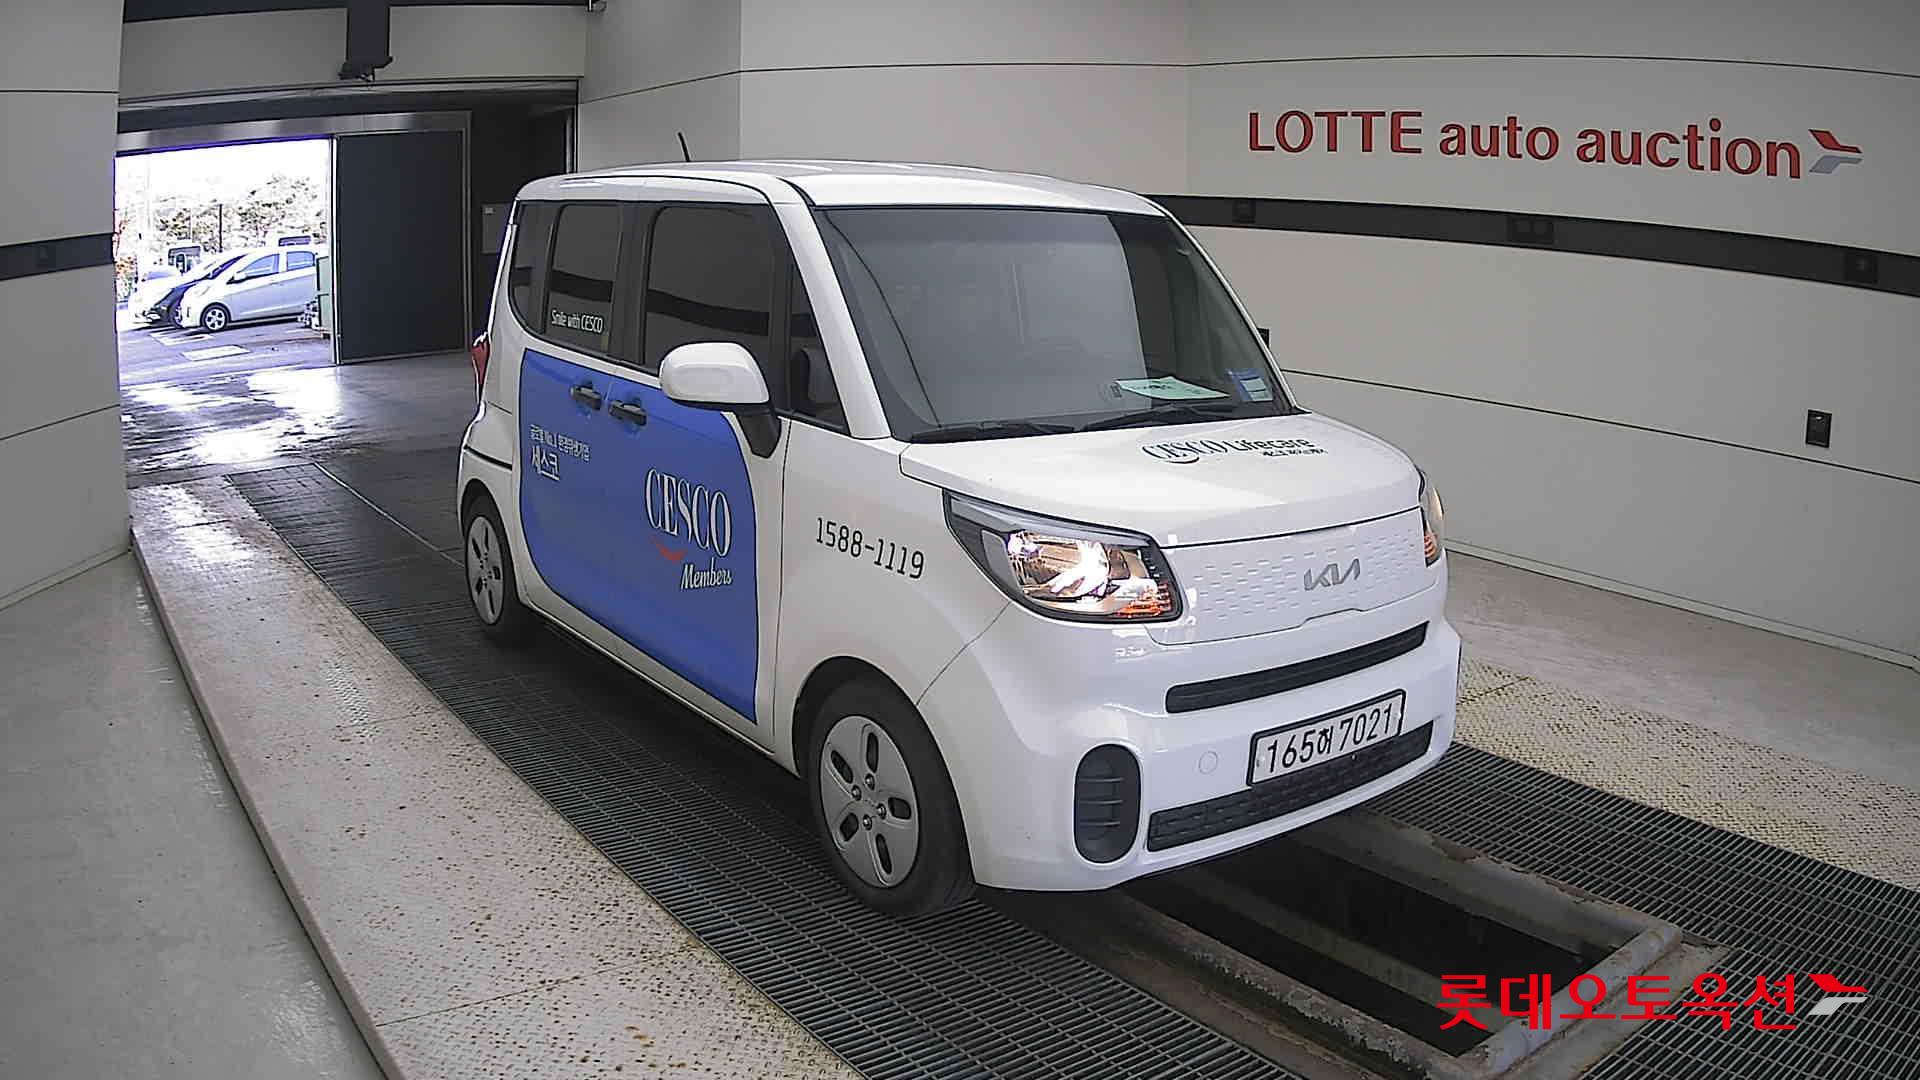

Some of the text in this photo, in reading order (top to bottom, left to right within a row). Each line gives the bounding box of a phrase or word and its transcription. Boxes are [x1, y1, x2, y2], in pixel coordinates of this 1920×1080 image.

[1248, 110, 1802, 179] LOTTE auto auction
[581, 314, 603, 334] CESCO
[531, 445, 560, 480] 세스코
[1142, 439, 1315, 459] CESCO Lifecare
[645, 468, 732, 557] CESCO
[816, 517, 924, 579] 1588-1119
[680, 557, 732, 590] Members
